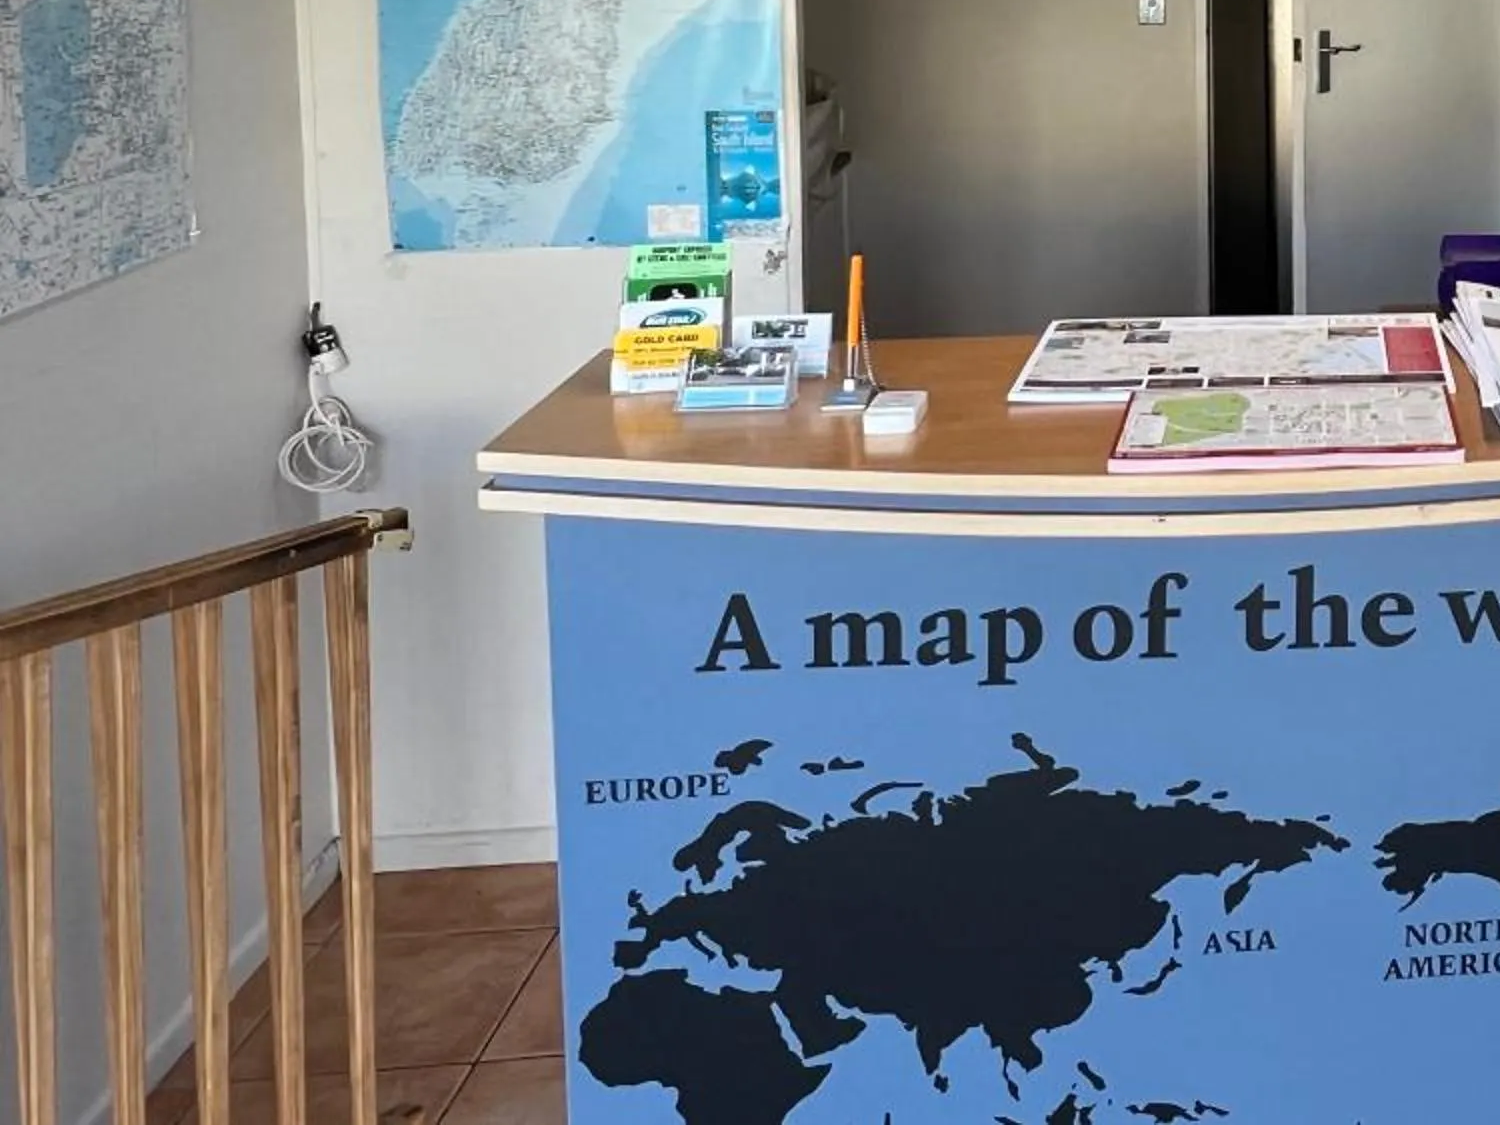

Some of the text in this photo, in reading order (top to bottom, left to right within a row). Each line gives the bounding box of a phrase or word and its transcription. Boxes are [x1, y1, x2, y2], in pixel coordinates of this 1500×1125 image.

[634, 335, 699, 344] GOLD CARD
[694, 592, 782, 673] A
[803, 606, 1043, 686] map
[1072, 572, 1189, 661] of
[1233, 564, 1416, 652] the
[585, 771, 732, 804] EUROPE
[1202, 930, 1277, 955] ASIA
